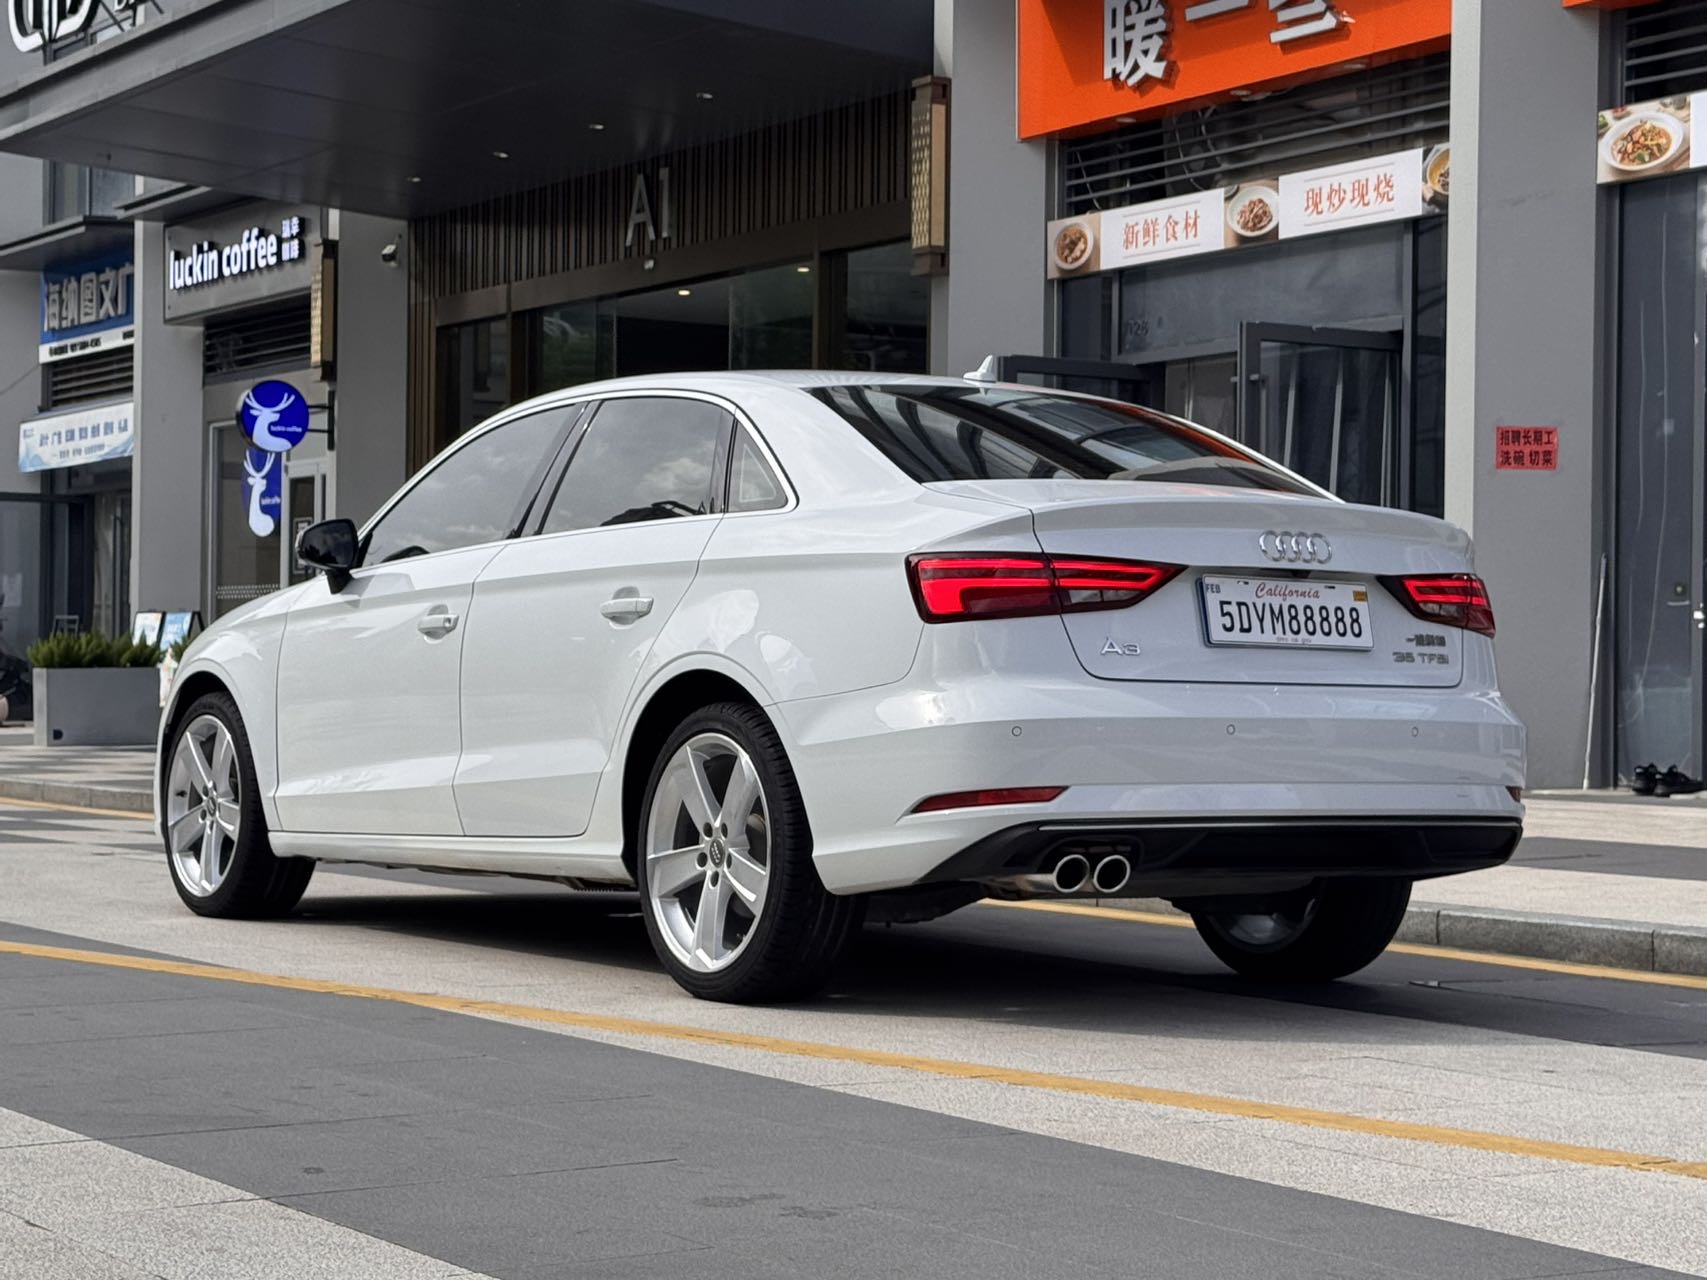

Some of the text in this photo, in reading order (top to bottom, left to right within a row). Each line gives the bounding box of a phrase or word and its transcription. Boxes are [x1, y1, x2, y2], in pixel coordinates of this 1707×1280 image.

[1304, 173, 1394, 216] 现炒现烧
[1122, 210, 1200, 251] 新鲜食材
[169, 227, 278, 290] luckin coffee
[1500, 429, 1553, 446] 招聘长期工
[1255, 582, 1321, 602] California
[1219, 600, 1363, 638] 5DYM88888
[1101, 639, 1141, 656] A3
